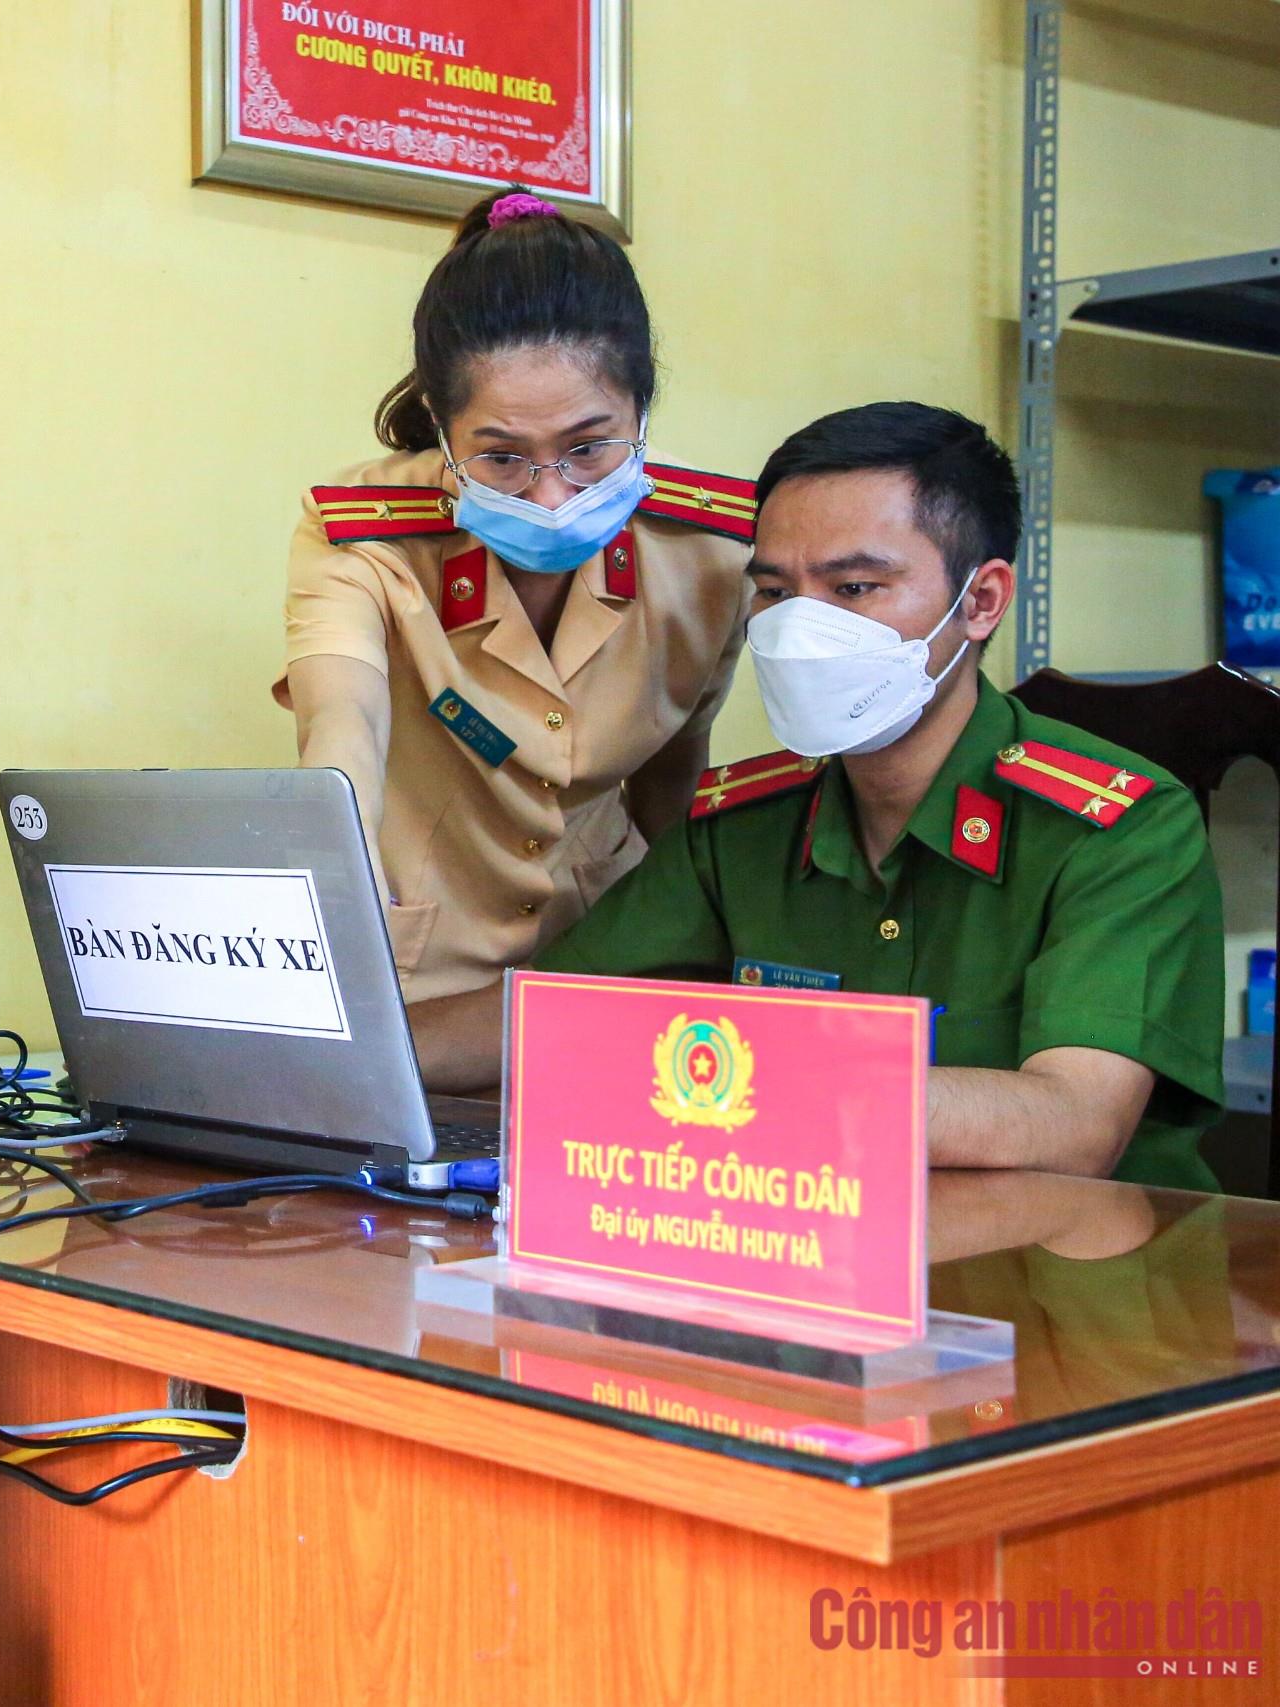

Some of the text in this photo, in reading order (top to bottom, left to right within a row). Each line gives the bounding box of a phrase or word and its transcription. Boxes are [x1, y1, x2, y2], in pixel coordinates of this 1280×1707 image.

[282, 1, 465, 57] ĐỐI VỚI ĐỊCH, PHẢI
[296, 34, 557, 106] CƯƠNG QUYẾT, KHÔN KHÉO.
[14, 806, 44, 830] 253
[67, 919, 324, 972] BÀN ĐĂNG KÝ XE
[562, 1140, 861, 1219] TRỰC TIẾP CÔNG DÂN
[590, 1204, 823, 1270] Đại úy NGUYỄN HUY HÀ
